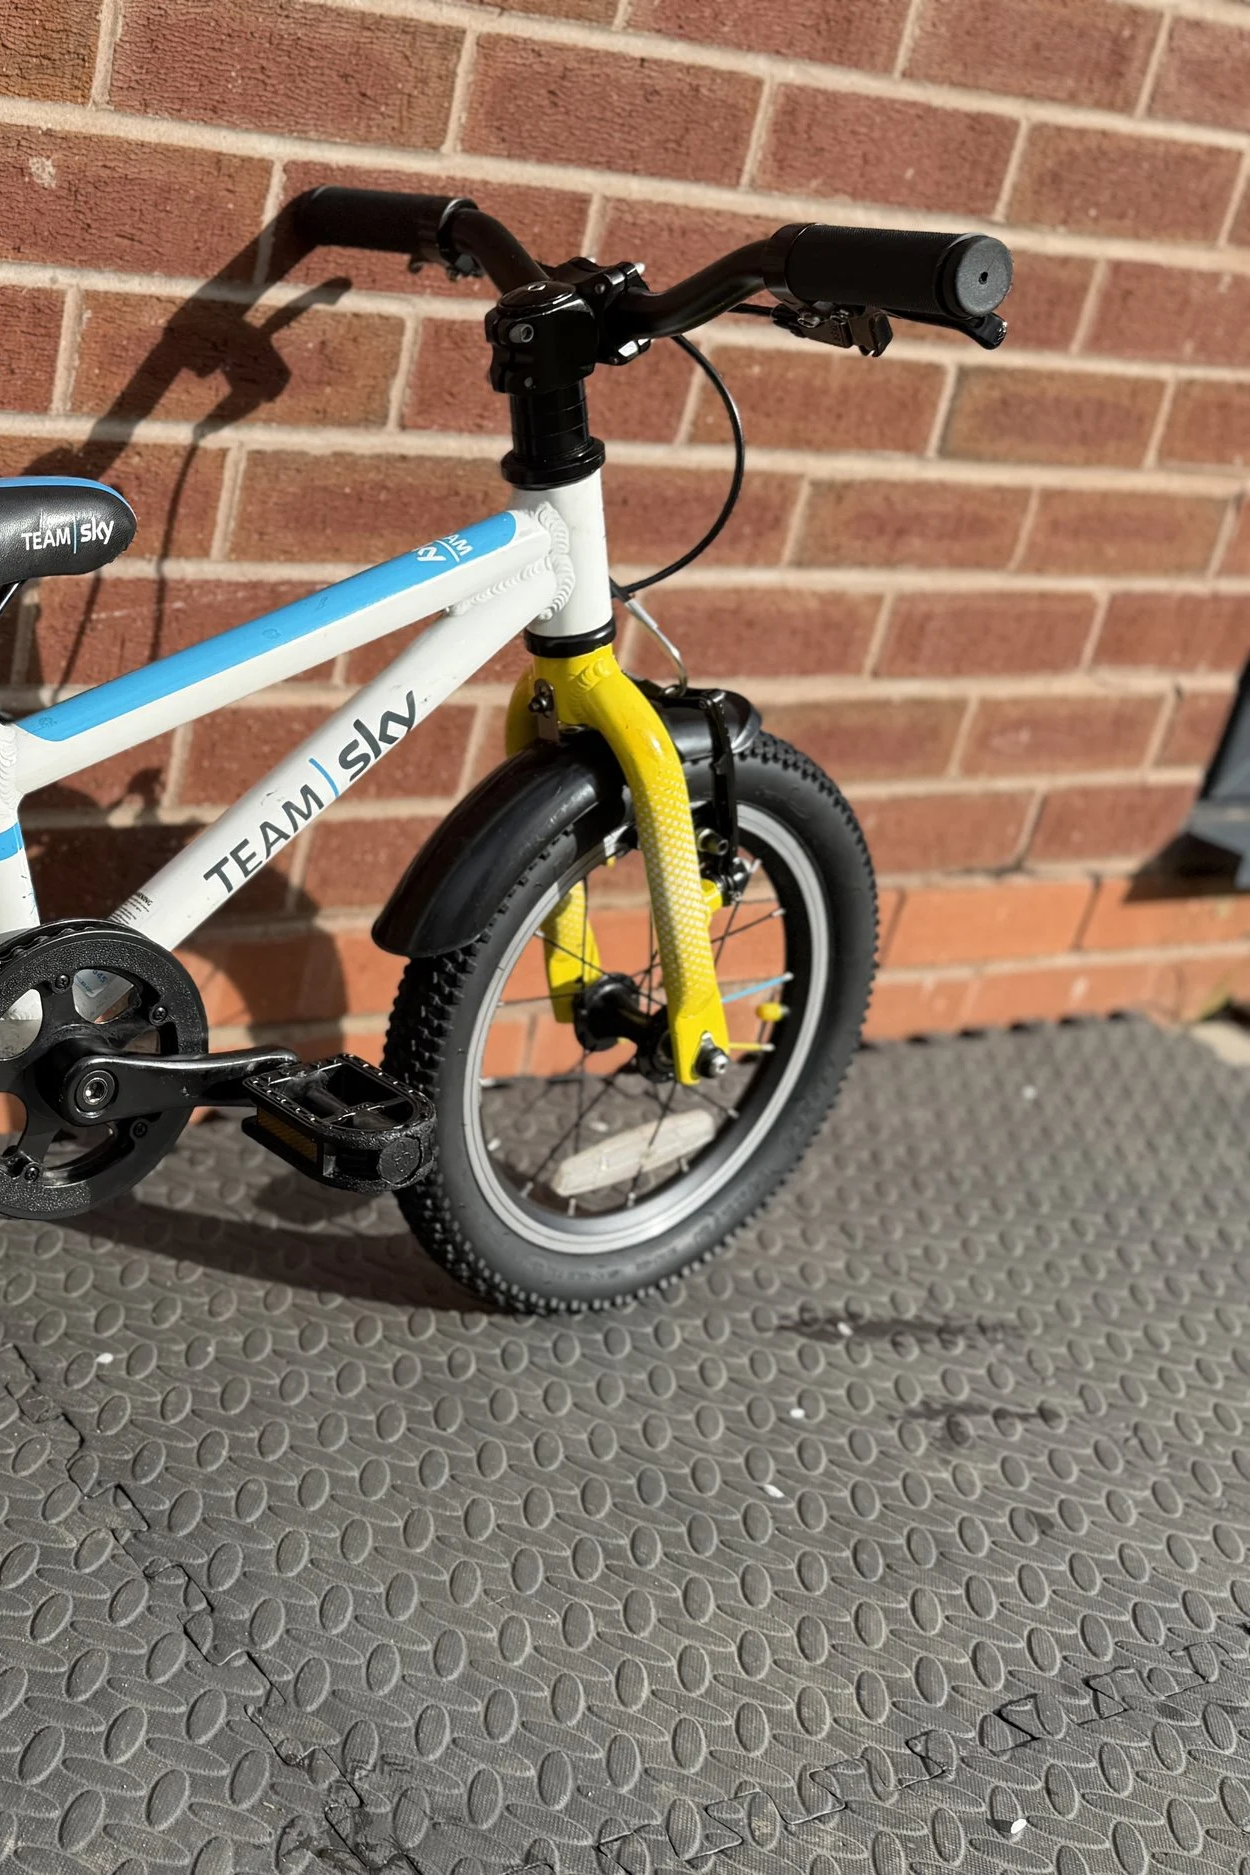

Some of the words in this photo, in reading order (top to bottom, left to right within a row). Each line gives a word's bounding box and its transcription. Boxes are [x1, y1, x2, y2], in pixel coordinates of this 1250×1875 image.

[21, 526, 71, 551] TEAM
[80, 515, 114, 544] sky
[202, 783, 325, 893] TEAM
[338, 689, 417, 782] sky
